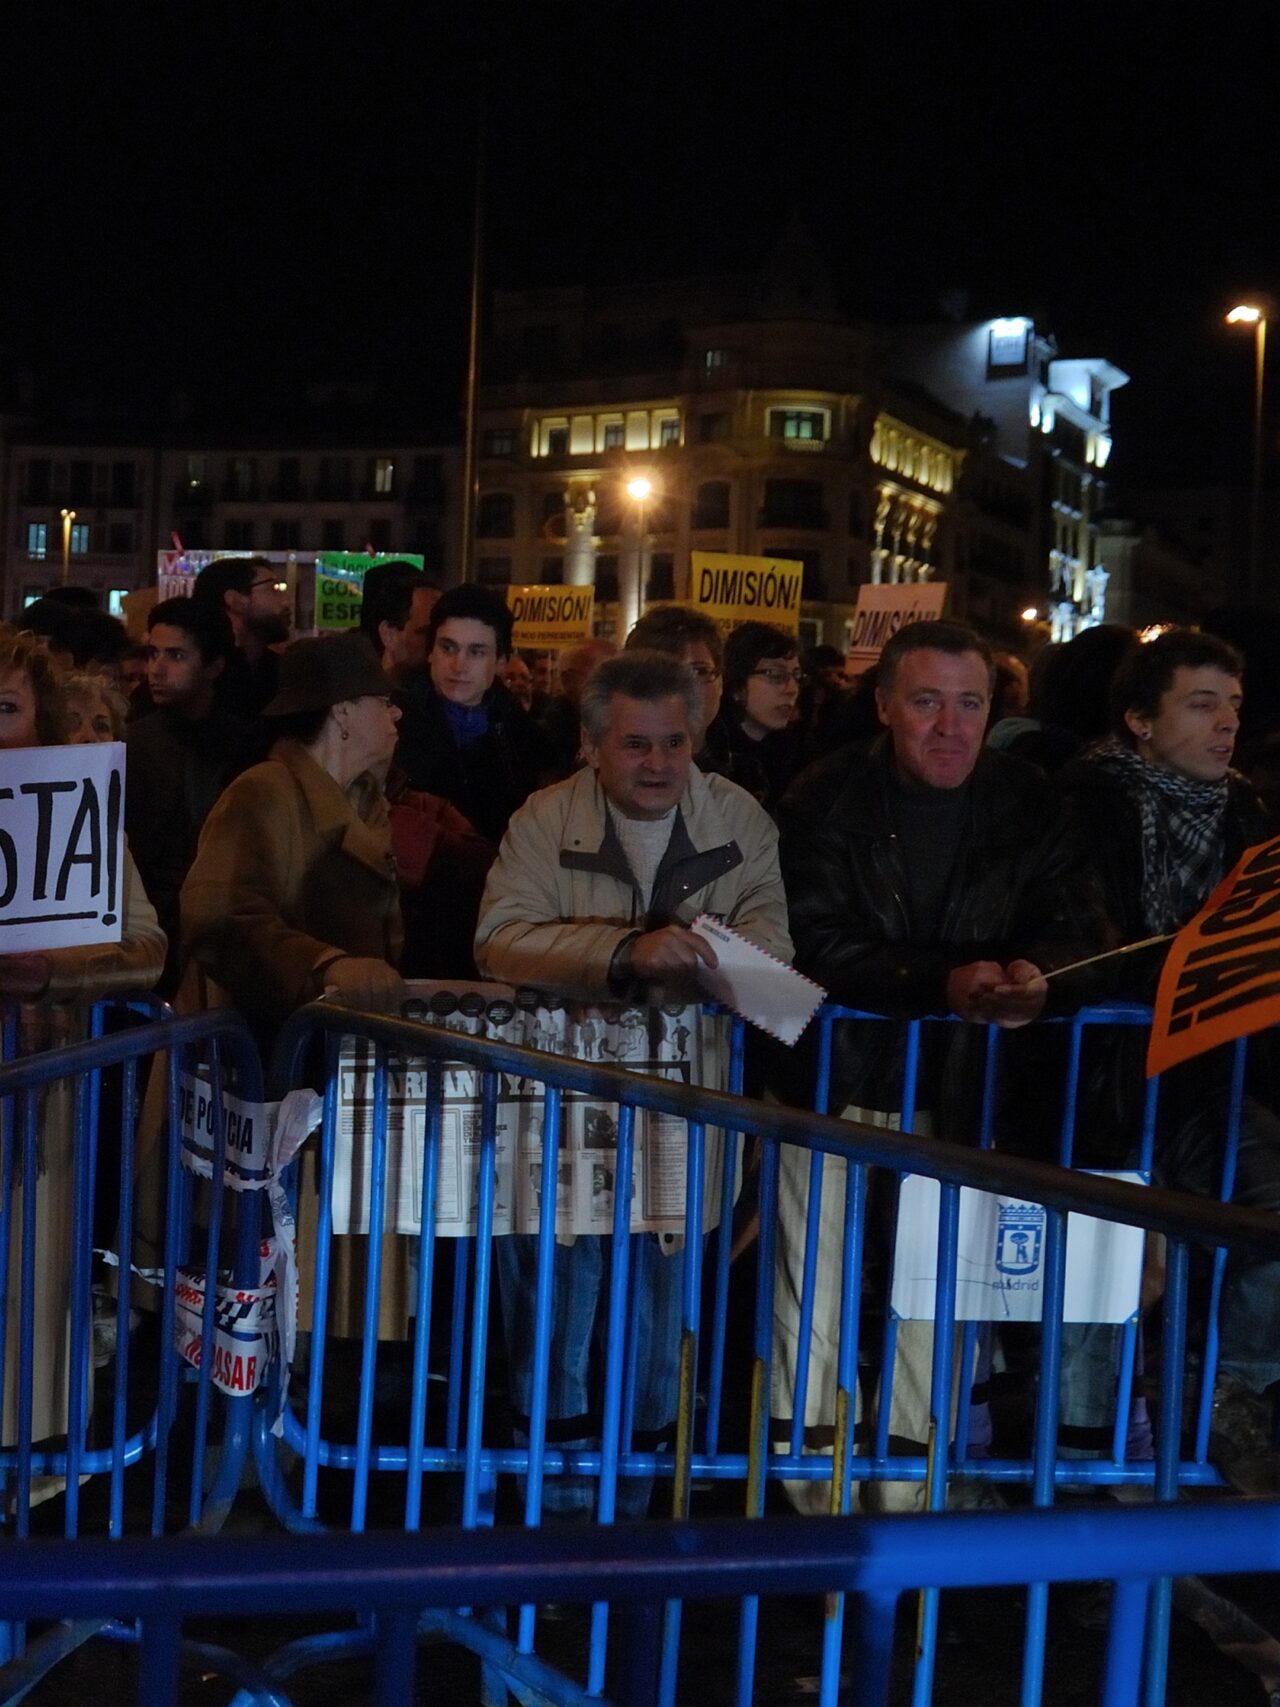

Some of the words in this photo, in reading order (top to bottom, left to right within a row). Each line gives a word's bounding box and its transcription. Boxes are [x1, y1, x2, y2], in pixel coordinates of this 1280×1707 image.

[513, 590, 591, 622] DIMISIÓN!
[699, 565, 799, 610] DIMISIÓN!
[197, 1095, 253, 1154] POICIA
[212, 1343, 257, 1391] ASAR
